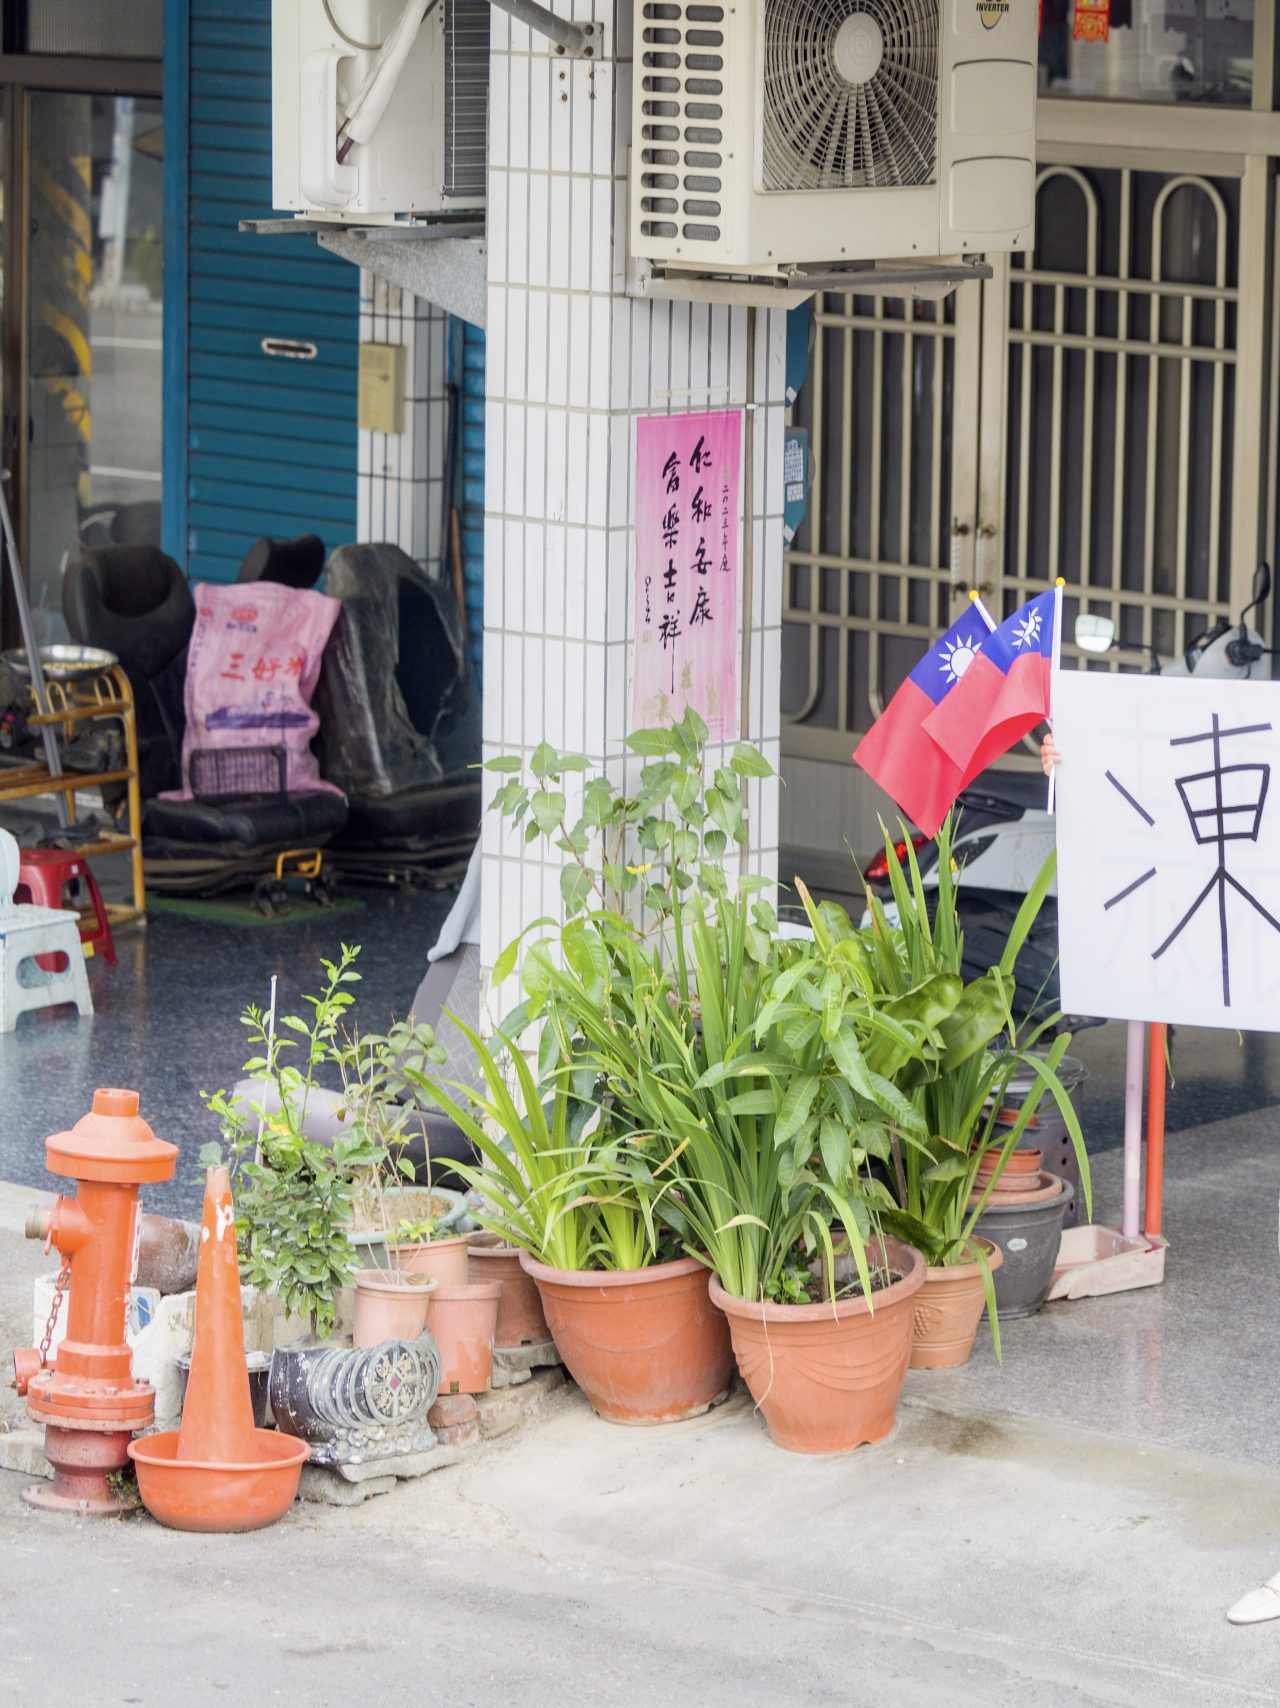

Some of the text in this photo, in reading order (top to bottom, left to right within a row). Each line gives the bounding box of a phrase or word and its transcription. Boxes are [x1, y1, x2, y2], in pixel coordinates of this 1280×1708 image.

[976, 2, 1010, 12] INVERTER
[689, 435, 715, 627] 仁和安康
